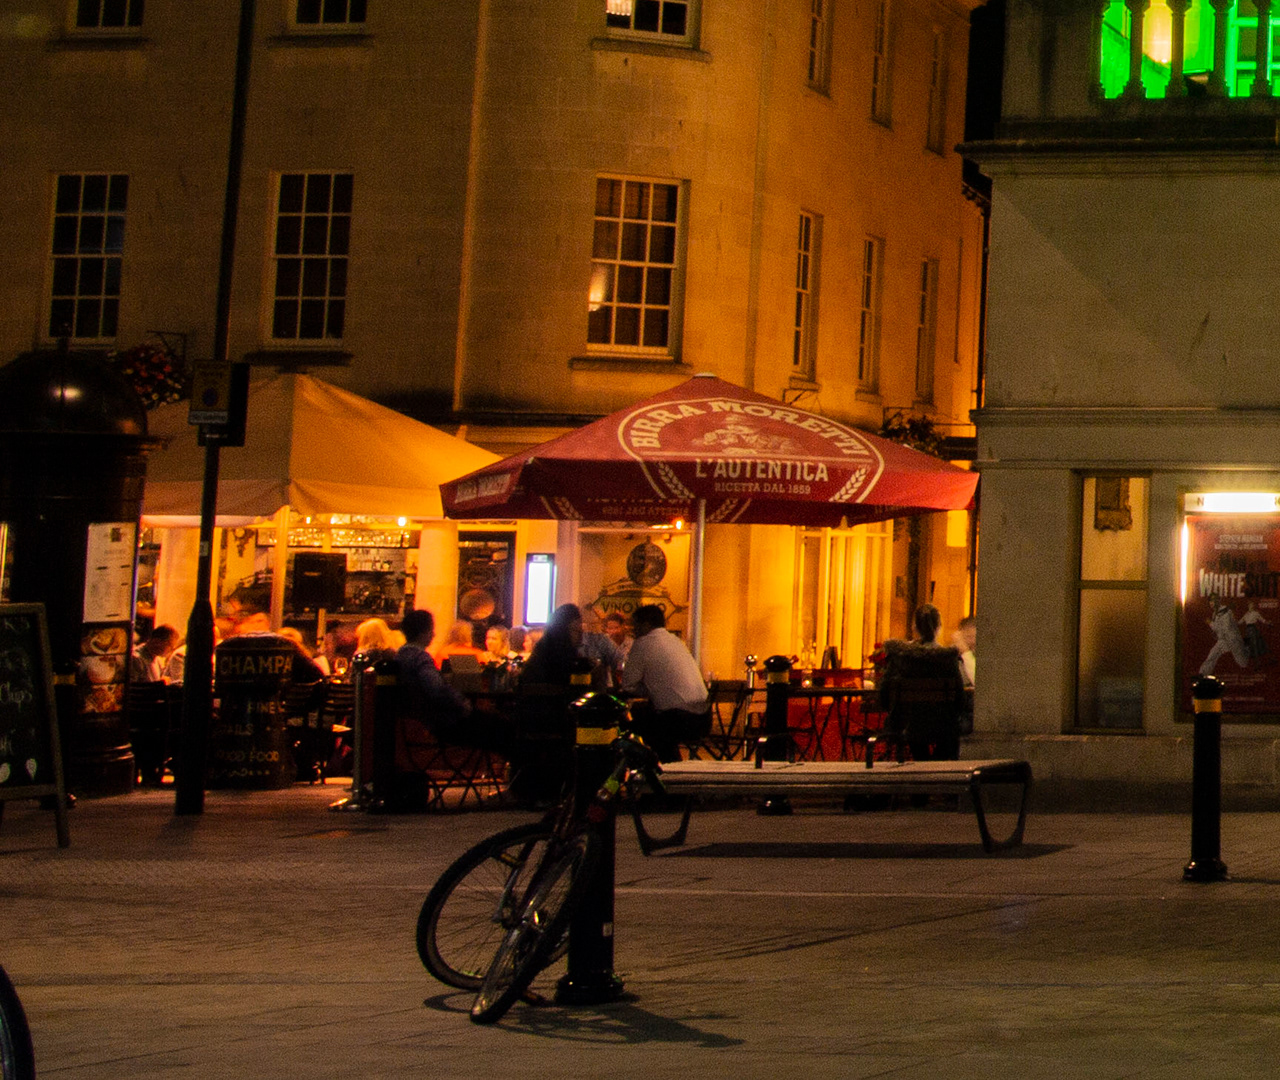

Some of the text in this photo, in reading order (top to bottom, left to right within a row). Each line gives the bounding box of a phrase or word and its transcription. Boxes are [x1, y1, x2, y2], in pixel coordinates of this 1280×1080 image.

[629, 399, 872, 456] BIRRA MORETTI
[695, 458, 830, 483] L'AUTENTICA
[714, 482, 761, 493] RICETTA
[763, 483, 786, 494] DAL
[1199, 568, 1247, 598] WHITE
